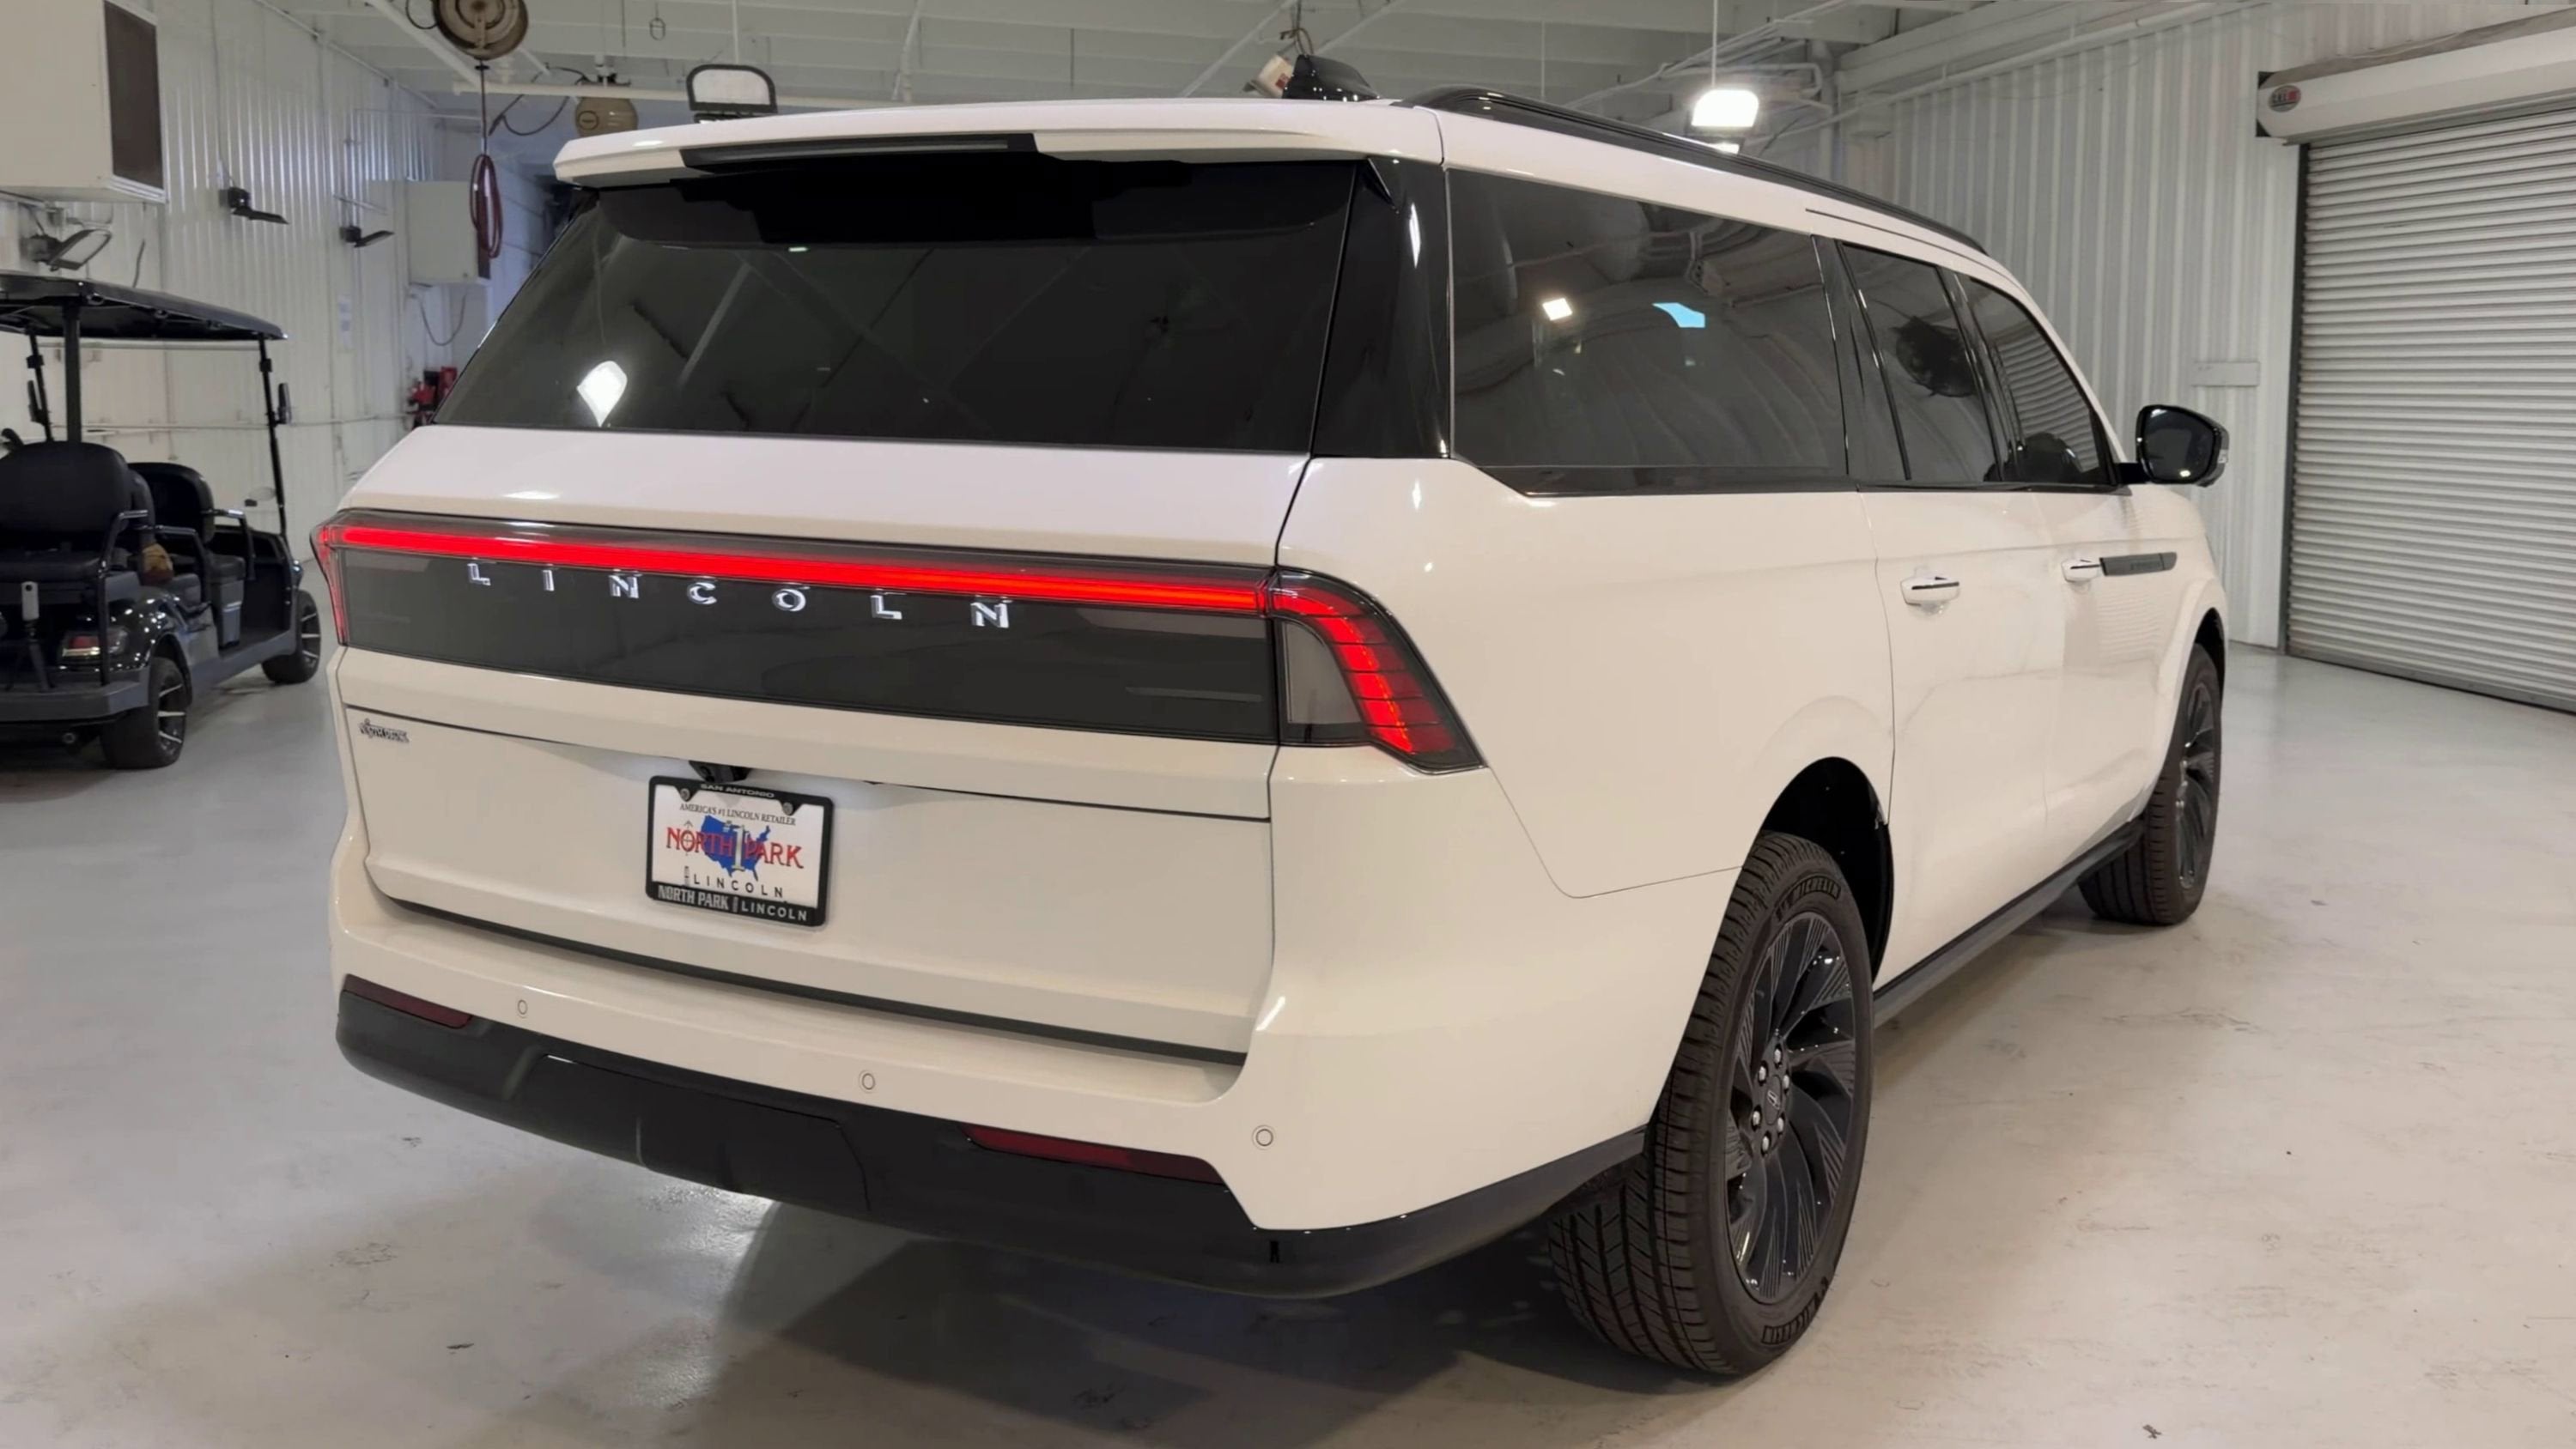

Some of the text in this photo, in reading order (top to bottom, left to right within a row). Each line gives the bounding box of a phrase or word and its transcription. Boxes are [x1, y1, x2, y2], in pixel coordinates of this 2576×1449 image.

[467, 559, 1010, 628] LINCOLN
[726, 786, 775, 798] ANTONIO
[680, 803, 717, 815] AMERICA'S
[726, 809, 760, 822] LINCOLN
[761, 814, 796, 826] RETAILER
[666, 827, 804, 869] NORTH PARK
[694, 874, 783, 898] LINCOLN
[658, 885, 807, 921] NORTH PARK LINCOLN
